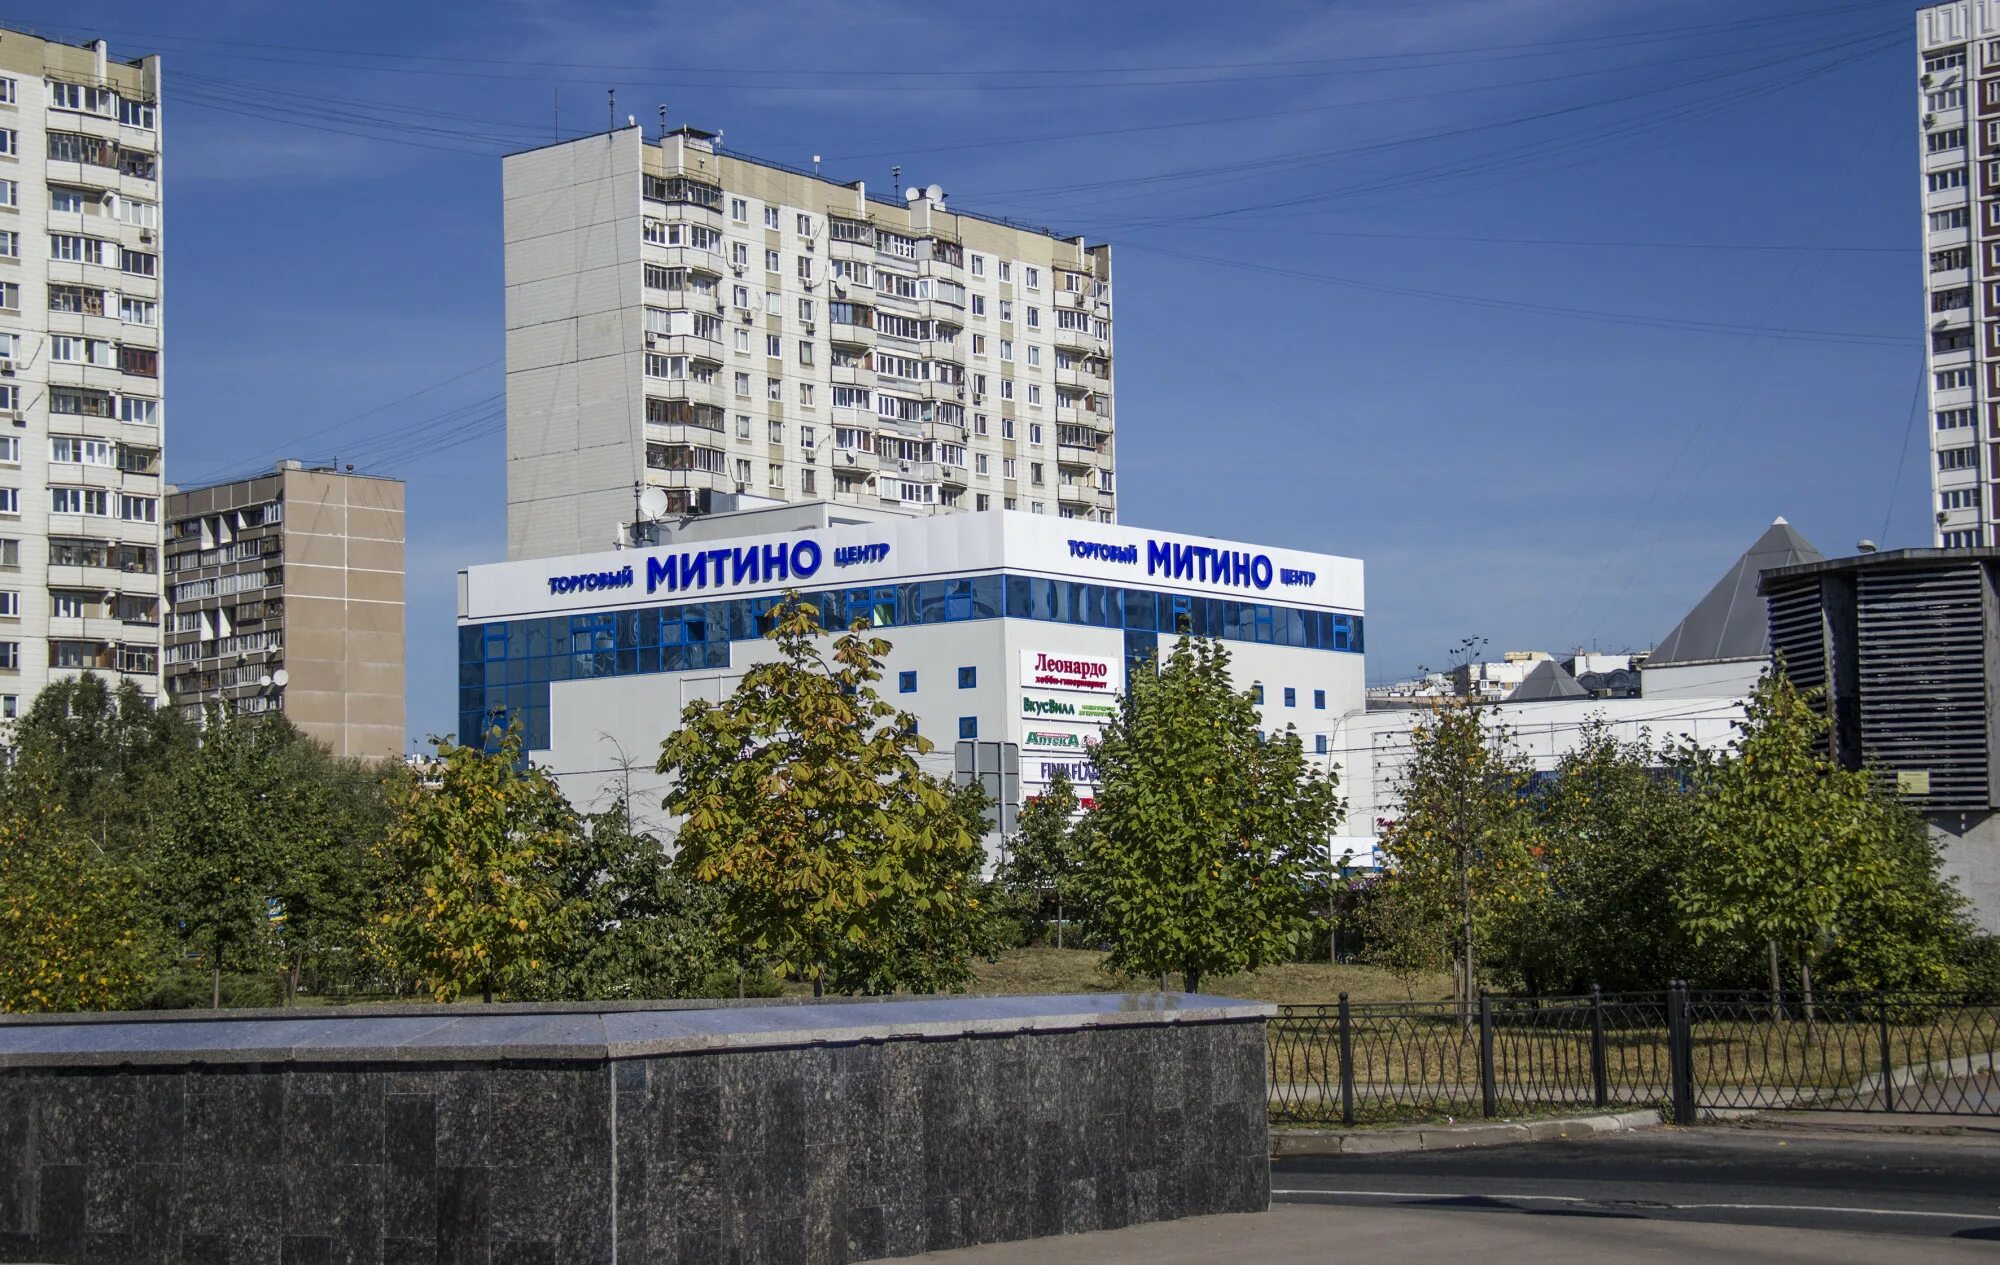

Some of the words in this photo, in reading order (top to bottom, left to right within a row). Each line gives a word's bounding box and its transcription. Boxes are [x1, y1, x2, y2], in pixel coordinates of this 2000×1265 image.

[548, 565, 634, 595] ТОРГОВЫЙ
[646, 539, 822, 594] МИТИНО
[833, 542, 891, 568] ЦЕНТР
[1067, 539, 1138, 565] ТОРГОВЫЙ
[1147, 539, 1273, 591] МИТИНО
[1279, 567, 1317, 588] ЦЕНТР
[1034, 653, 1107, 680] Леонардо
